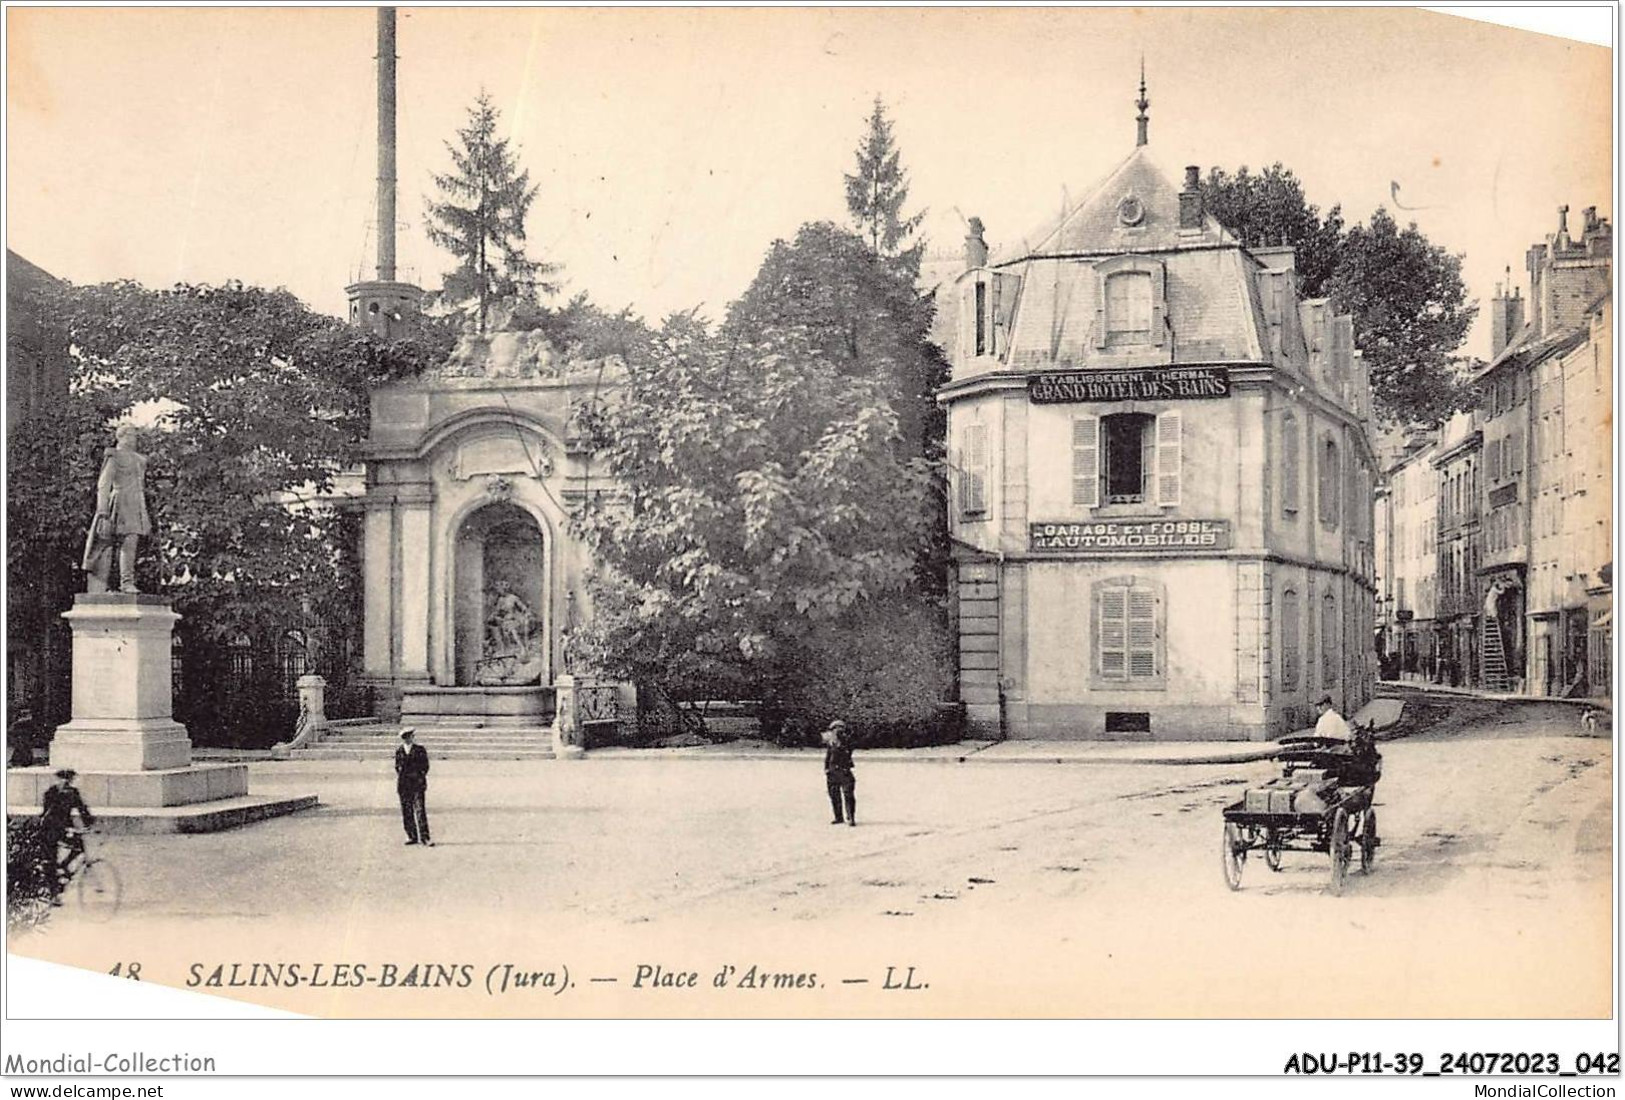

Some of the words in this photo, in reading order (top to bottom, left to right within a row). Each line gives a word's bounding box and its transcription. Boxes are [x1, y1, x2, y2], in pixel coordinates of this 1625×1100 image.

[1040, 373, 1143, 384] ETABLISSEMENT
[1154, 370, 1214, 380] THERMAL
[1032, 383, 1085, 399] GRAND
[1142, 381, 1174, 396] DES
[1178, 378, 1226, 395] BAINS
[1044, 524, 1118, 536] GARAGE
[1123, 525, 1143, 534] ET
[1151, 522, 1212, 534] FOSSE
[1036, 533, 1216, 547] d'AUTOMOBILES
